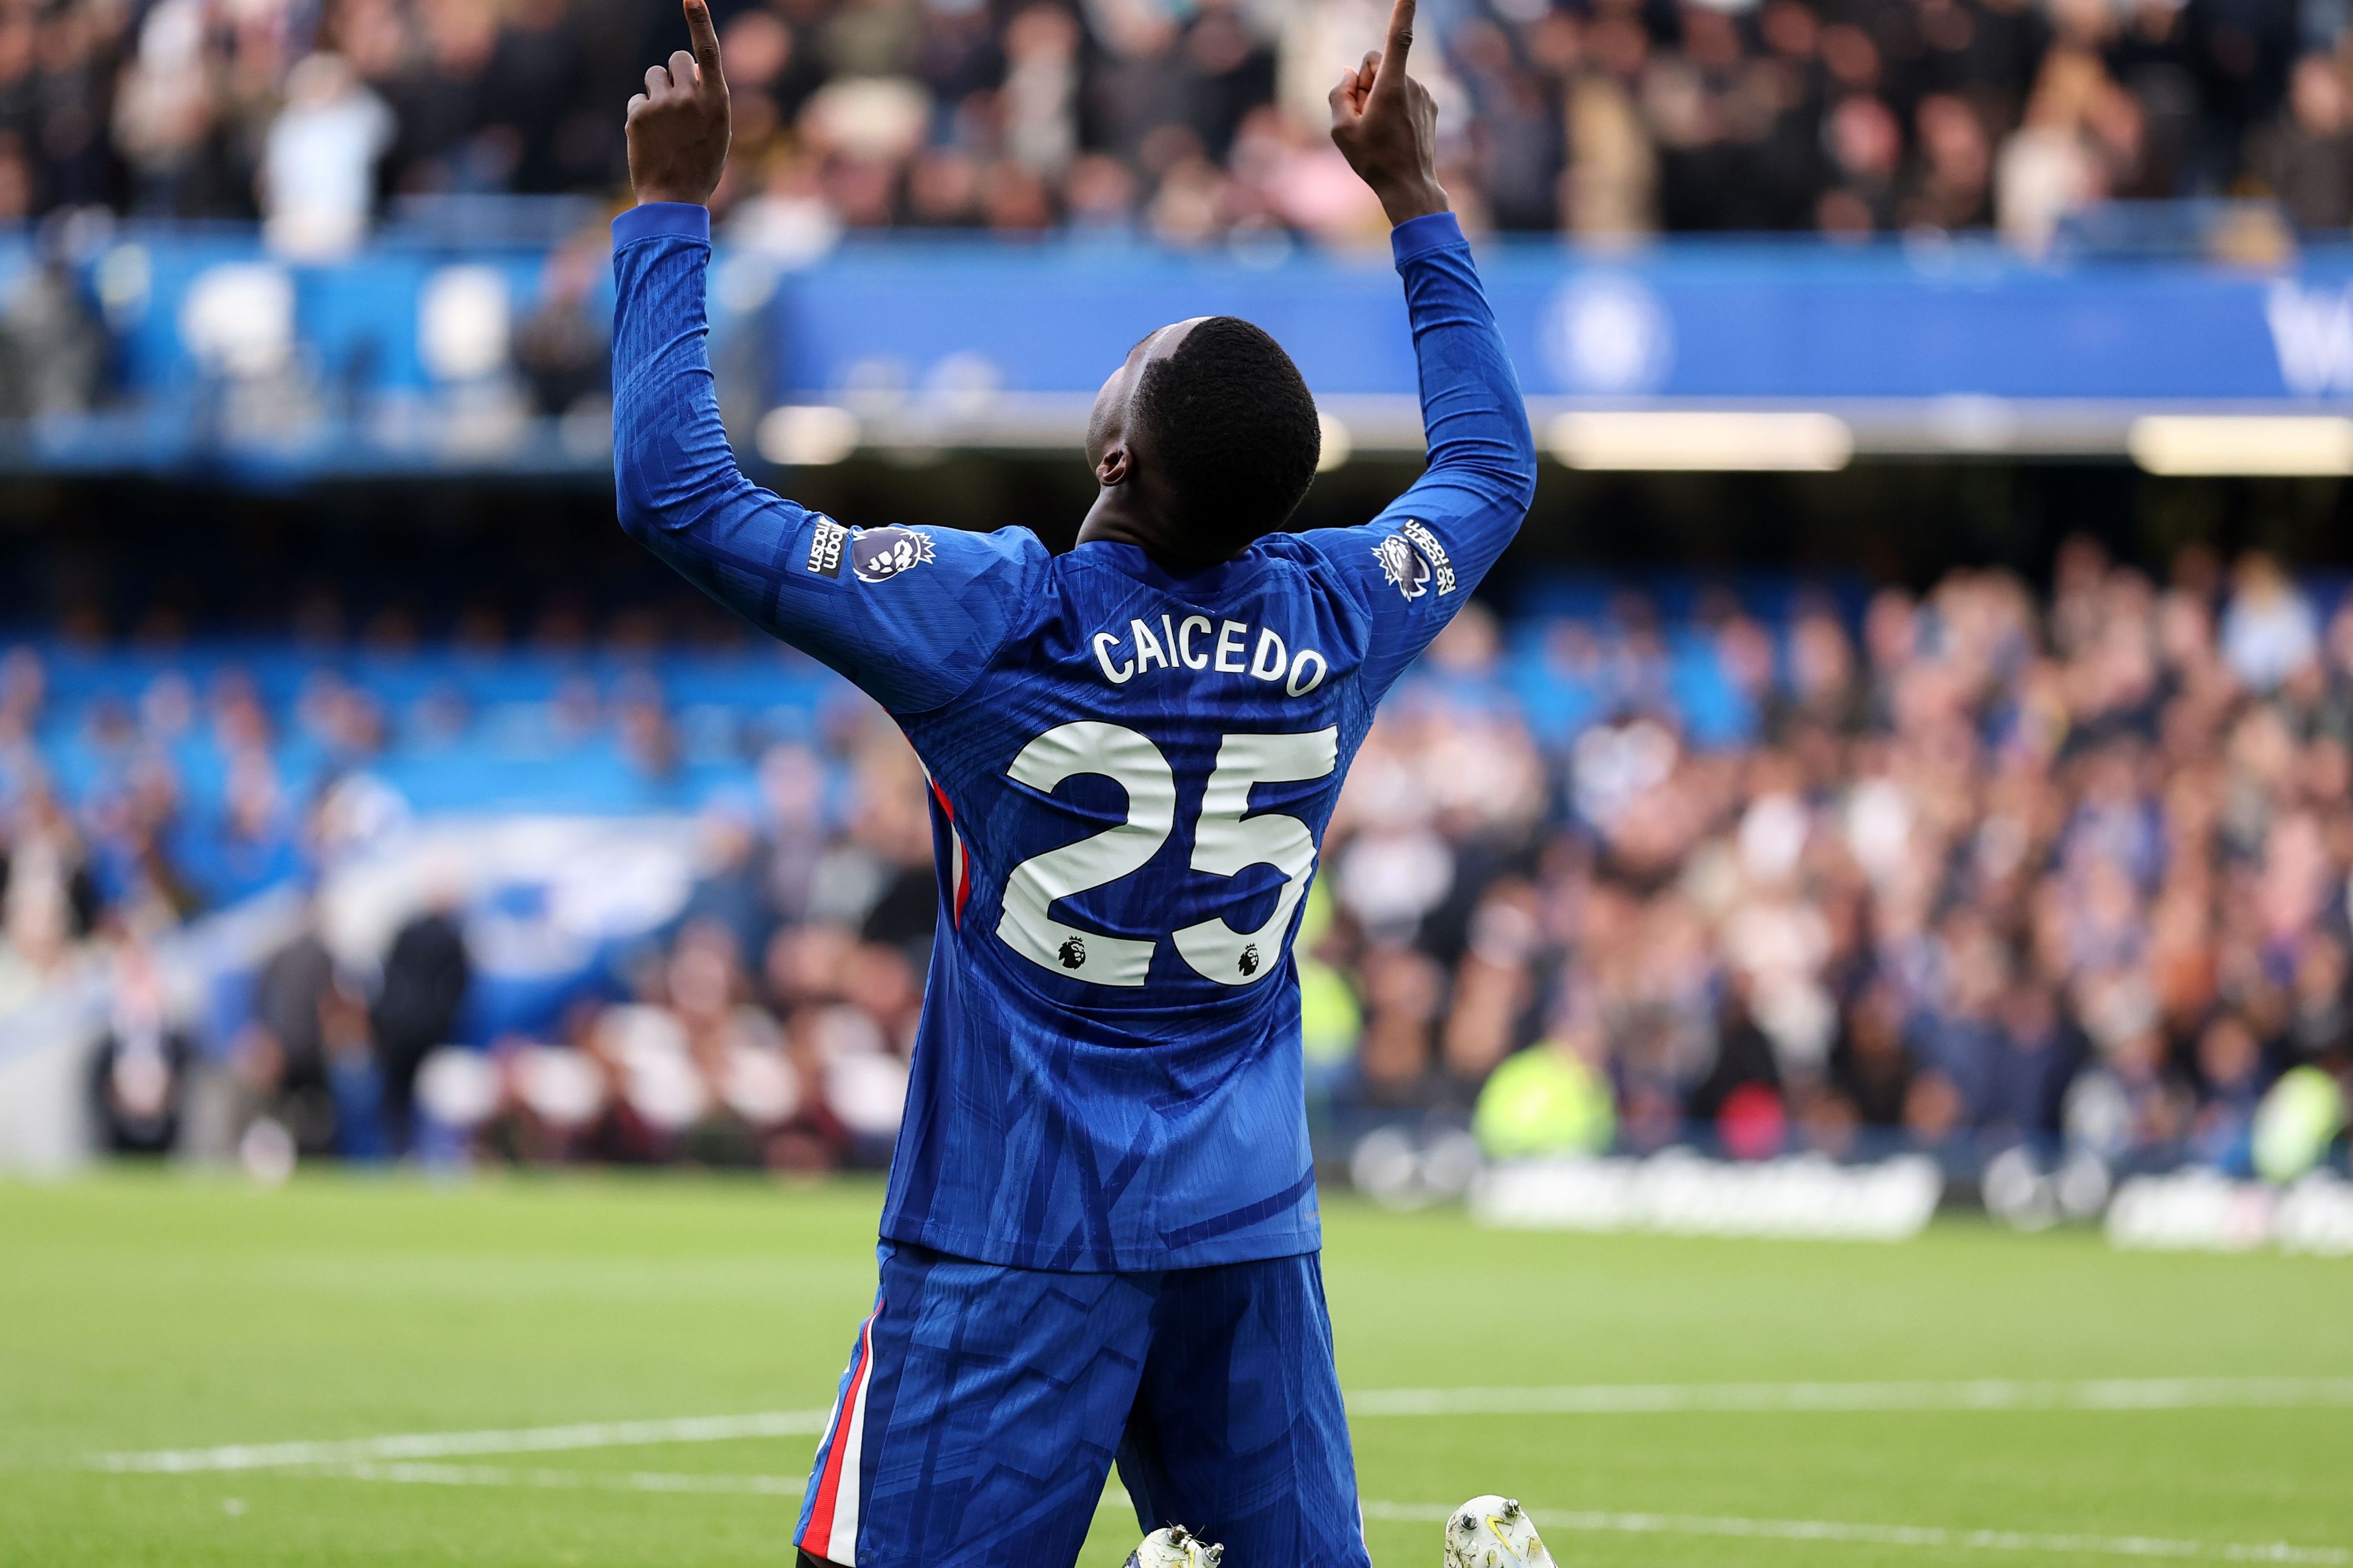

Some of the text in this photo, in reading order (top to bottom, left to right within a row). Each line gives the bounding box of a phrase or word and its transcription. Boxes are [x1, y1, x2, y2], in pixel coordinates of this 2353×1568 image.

[807, 523, 830, 573] racism
[1405, 529, 1441, 566] room
[1406, 519, 1449, 564] racism
[1093, 614, 1328, 698] CAICEDO
[995, 719, 1339, 988] 25
